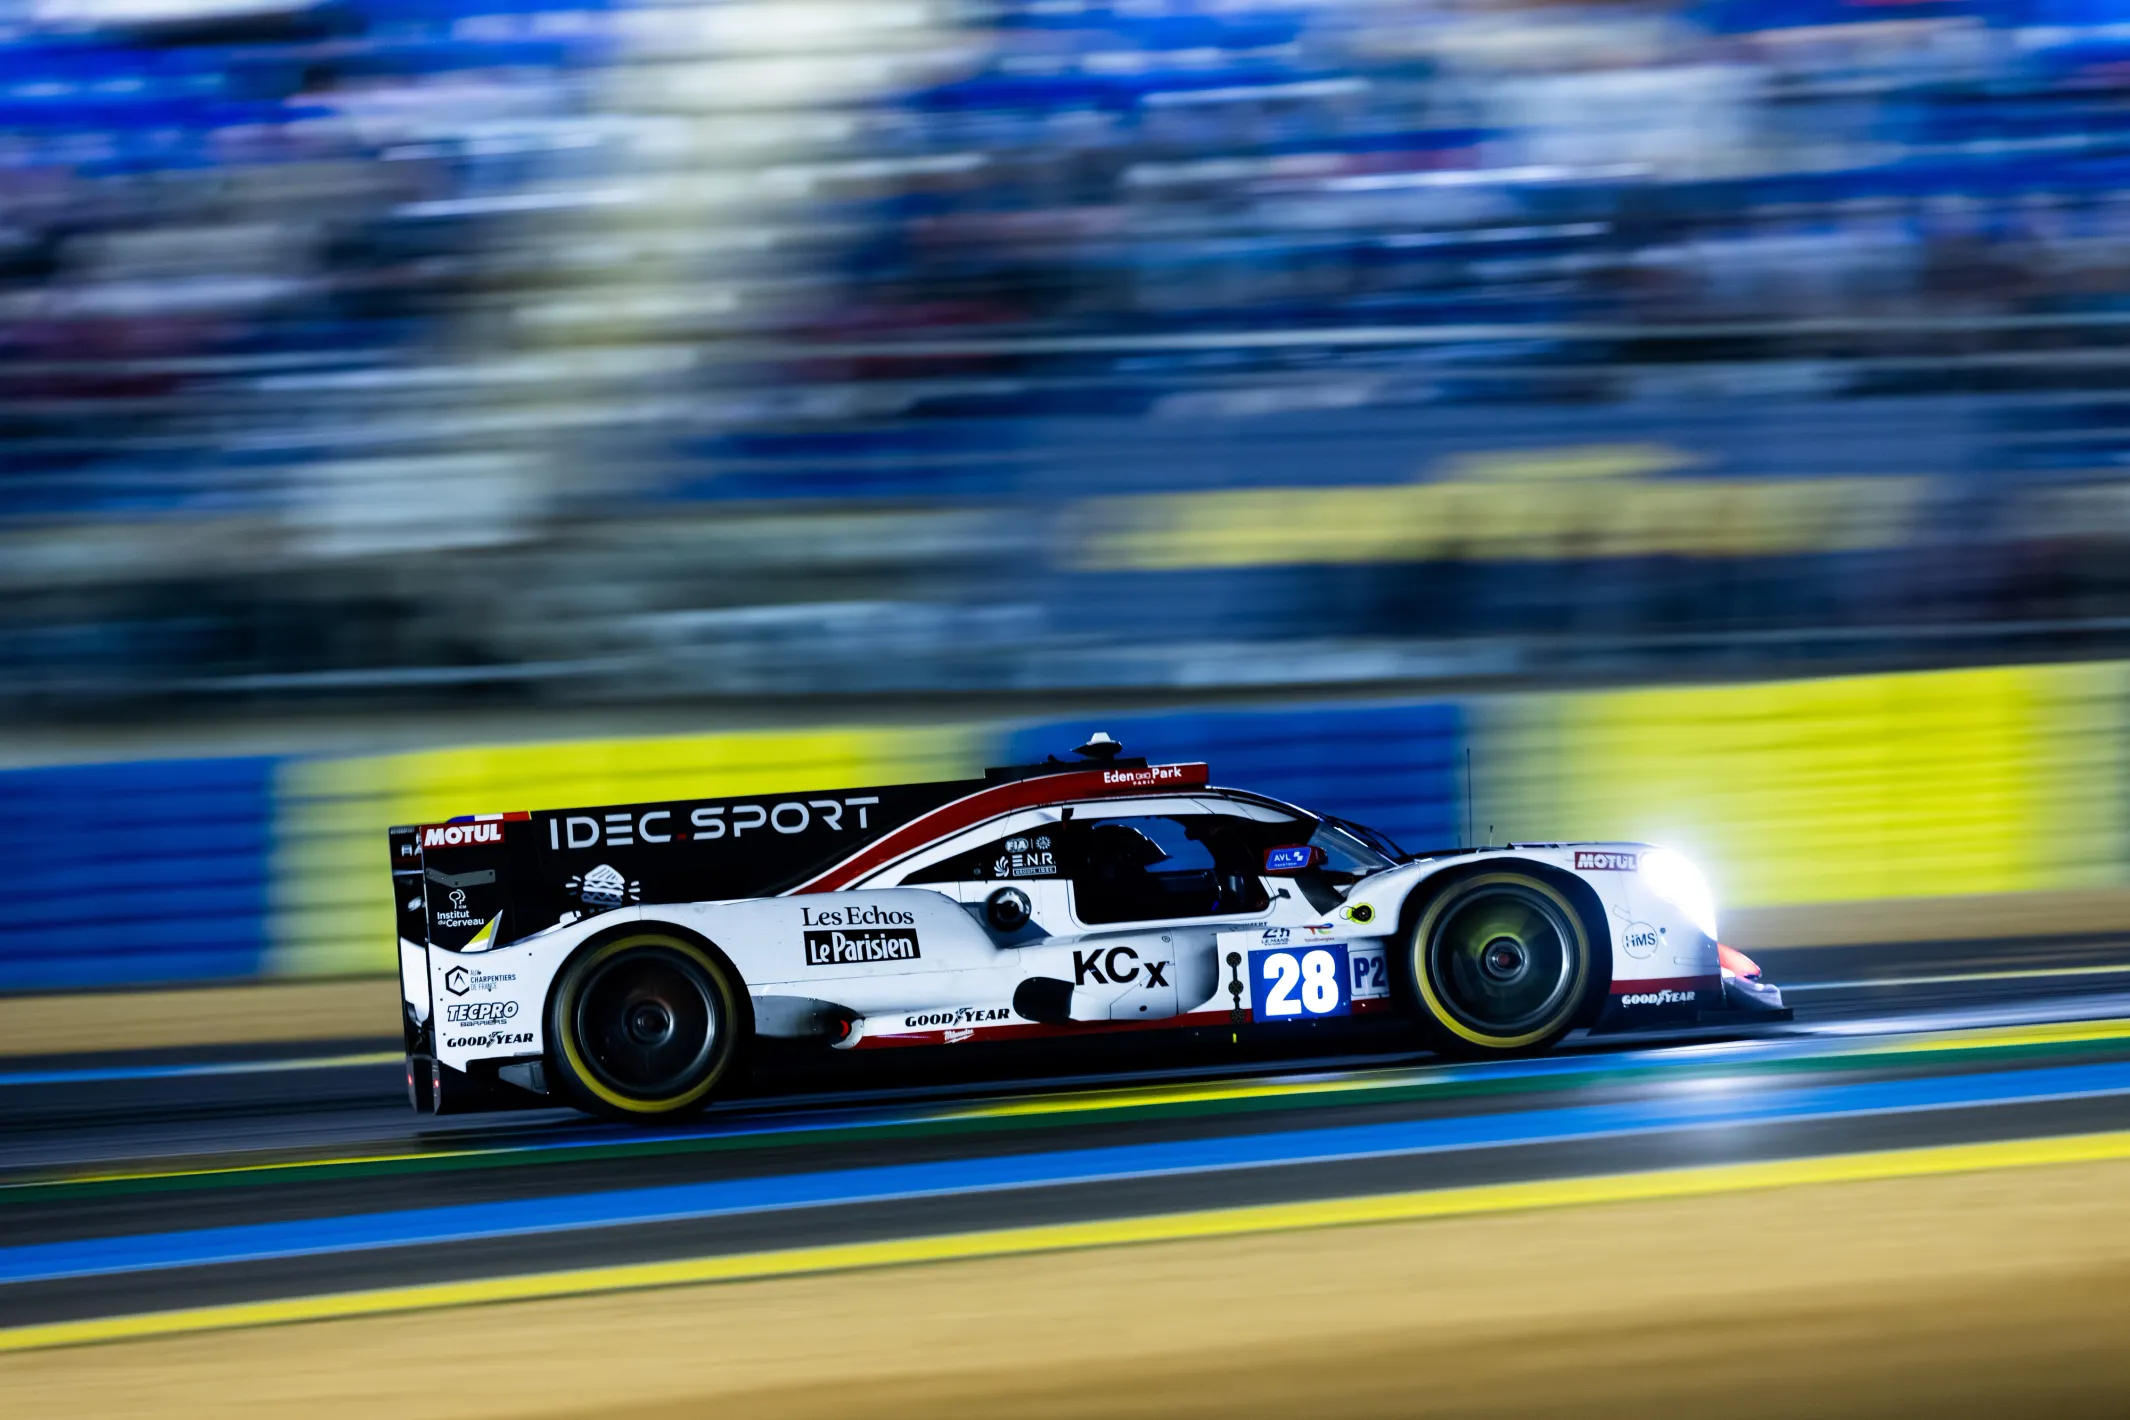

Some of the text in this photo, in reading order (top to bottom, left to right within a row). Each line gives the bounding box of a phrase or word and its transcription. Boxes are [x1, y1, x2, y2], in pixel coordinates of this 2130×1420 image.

[1103, 766, 1182, 784] Eden Park
[424, 823, 502, 846] MOTUL
[1006, 840, 1028, 851] FIA
[1274, 853, 1291, 862] AVL
[1577, 852, 1636, 870] MOTUL
[437, 910, 470, 920] Institut
[446, 918, 484, 928] Cerveau
[800, 905, 915, 926] Les Echos
[810, 931, 914, 964] Le Parisien
[1073, 946, 1170, 989] KCx
[1353, 956, 1386, 989] P2
[470, 973, 517, 984] CHARPENTIERS
[1263, 951, 1339, 1017] 28
[447, 1000, 519, 1022] TECPRO
